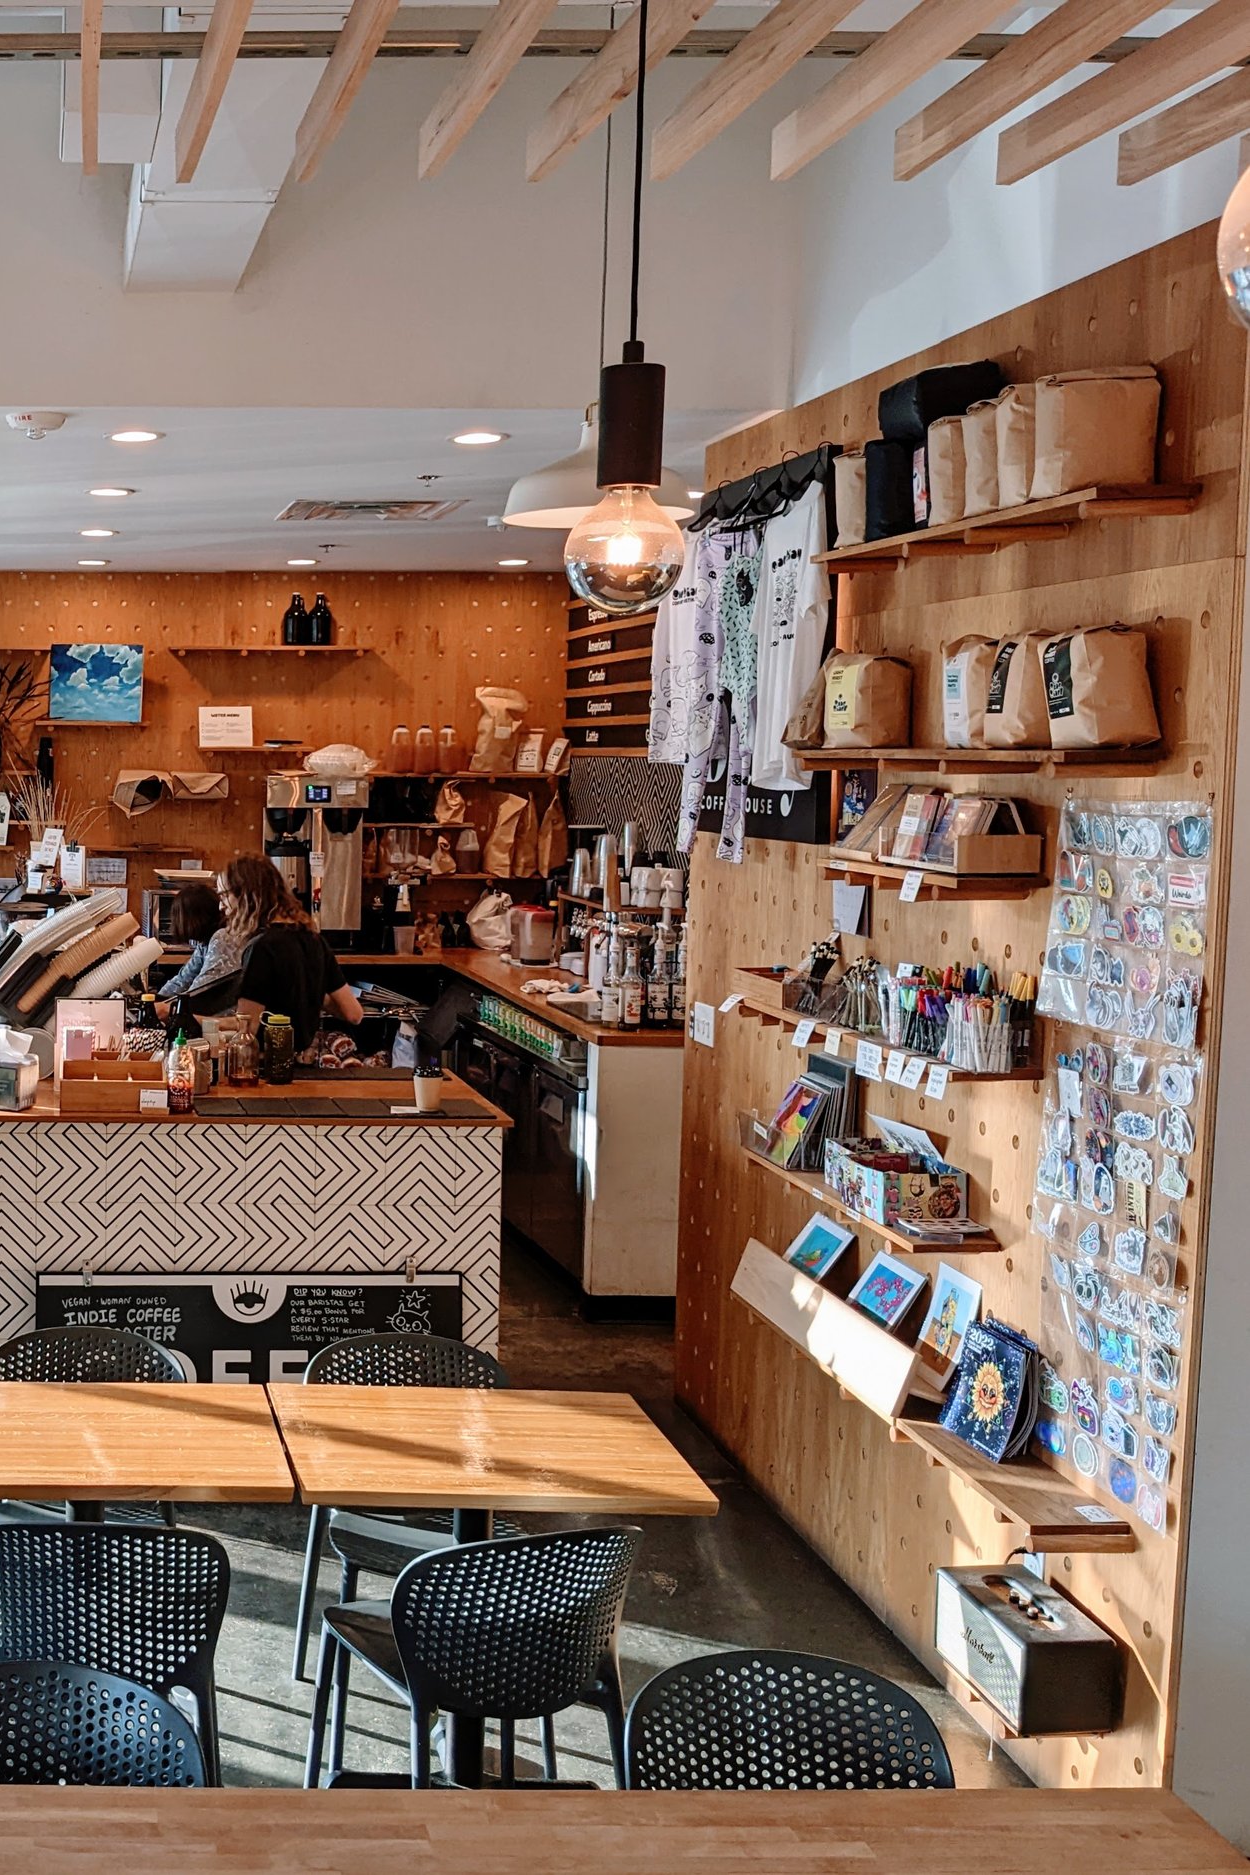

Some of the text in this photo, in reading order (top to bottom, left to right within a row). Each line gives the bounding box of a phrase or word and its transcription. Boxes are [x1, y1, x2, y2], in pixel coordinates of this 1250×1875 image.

[588, 638, 611, 652] Americano
[588, 668, 606, 682] Cortado
[587, 700, 612, 715] Cappuccino
[586, 730, 599, 742] Latte
[1125, 1182, 1136, 1222] WANTED
[293, 1288, 308, 1296] DID
[311, 1288, 327, 1296] YOU
[62, 1297, 166, 1308] VEGAN WOMAN OWNED
[64, 1307, 182, 1326] INDIE COFFEE
[970, 1328, 994, 1350] 2022
[960, 1626, 995, 1664] Marshall
